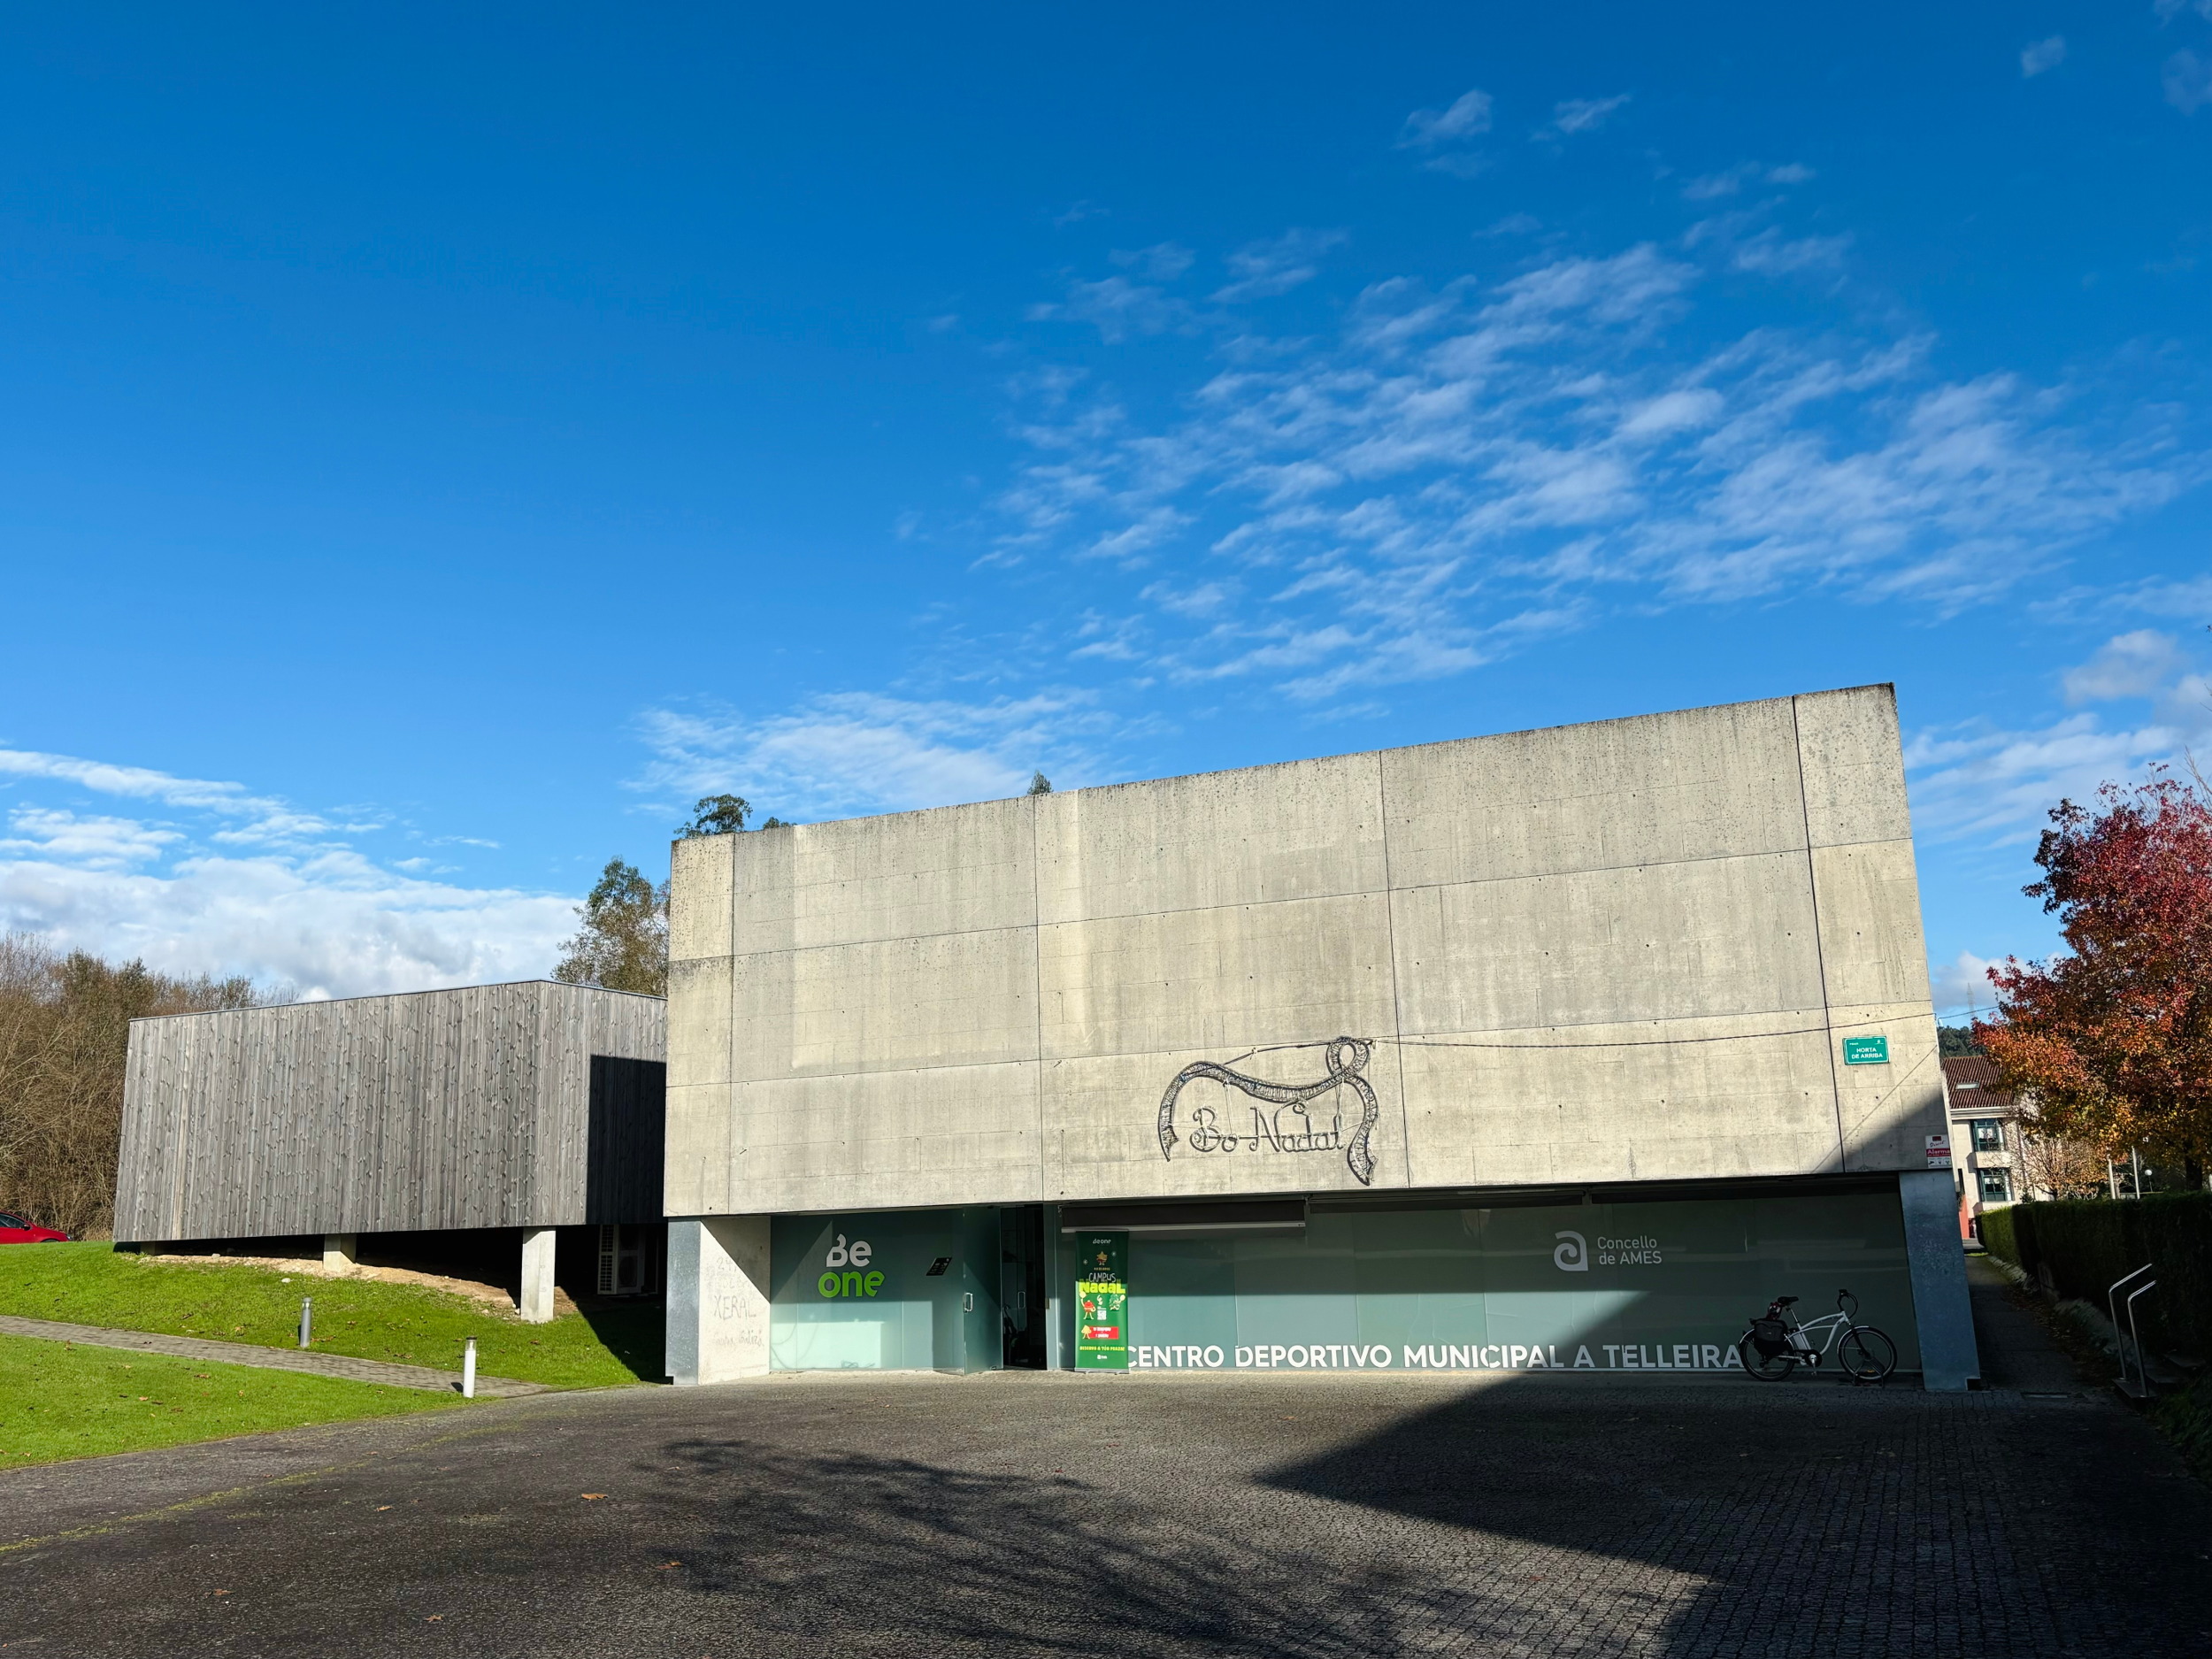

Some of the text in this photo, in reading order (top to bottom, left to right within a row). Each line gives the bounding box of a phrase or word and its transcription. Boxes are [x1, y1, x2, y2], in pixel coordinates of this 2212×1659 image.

[826, 1233, 872, 1267] Be
[1597, 1235, 1657, 1249] Concello
[1599, 1250, 1663, 1264] de AMES
[818, 1271, 886, 1298] one
[1088, 1272, 1117, 1283] CAMPUS
[713, 1294, 757, 1321] XERAL
[1234, 1344, 1393, 1368] DEPORTIVO
[1403, 1344, 1564, 1368] MUNICIPAL
[1573, 1344, 1595, 1368] A
[1602, 1344, 1745, 1368] TELLEIRA
